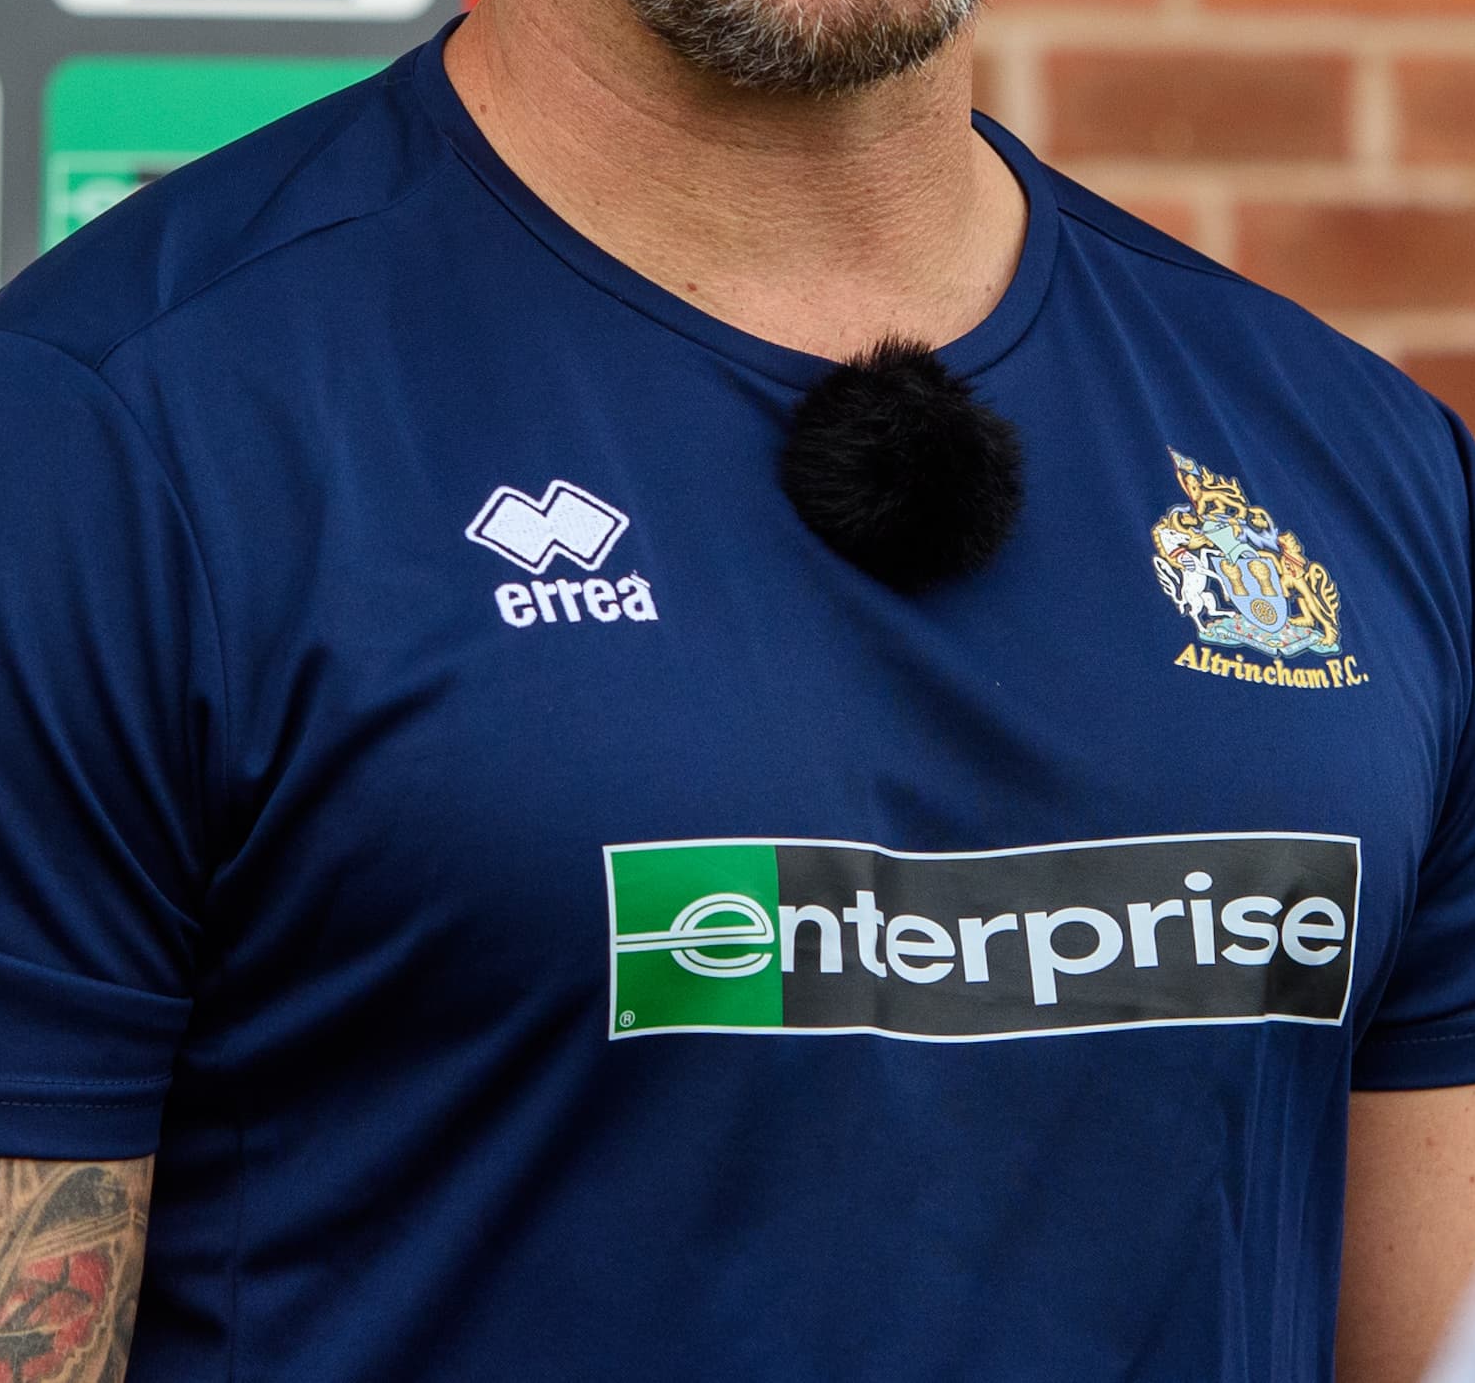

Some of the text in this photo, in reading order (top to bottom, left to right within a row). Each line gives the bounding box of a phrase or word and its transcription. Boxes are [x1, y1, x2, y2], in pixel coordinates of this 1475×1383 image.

[1174, 643, 1370, 689] Altrincham F.C.
[616, 871, 1347, 1005] enterprise
